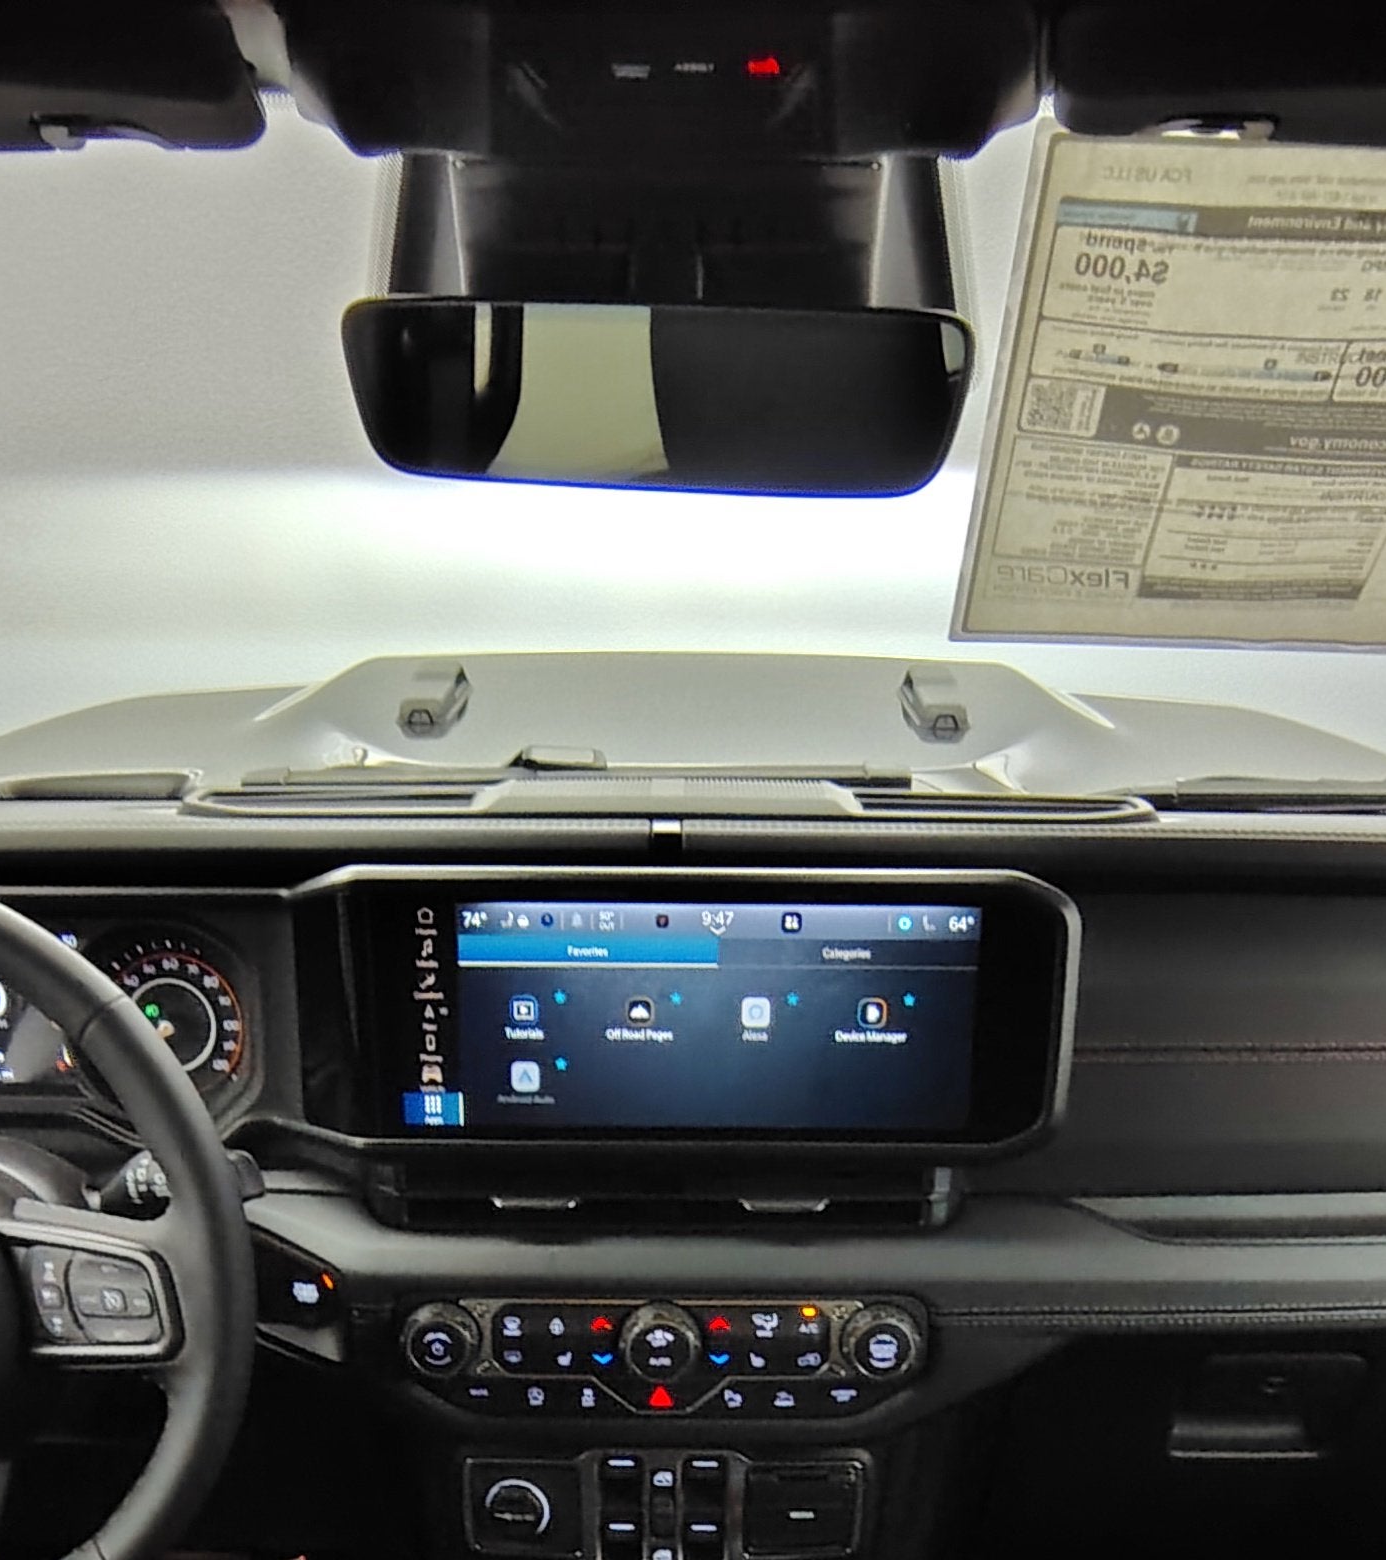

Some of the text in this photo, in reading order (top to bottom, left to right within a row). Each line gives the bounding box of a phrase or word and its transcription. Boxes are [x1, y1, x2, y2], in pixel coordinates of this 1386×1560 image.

[462, 911, 488, 929] 74°
[701, 910, 734, 927] 9:47
[948, 915, 976, 933] 64°
[567, 945, 609, 958] Favorites
[821, 947, 872, 962] Categories
[504, 1026, 545, 1041] Tutorials
[834, 1030, 907, 1044] Device Manager
